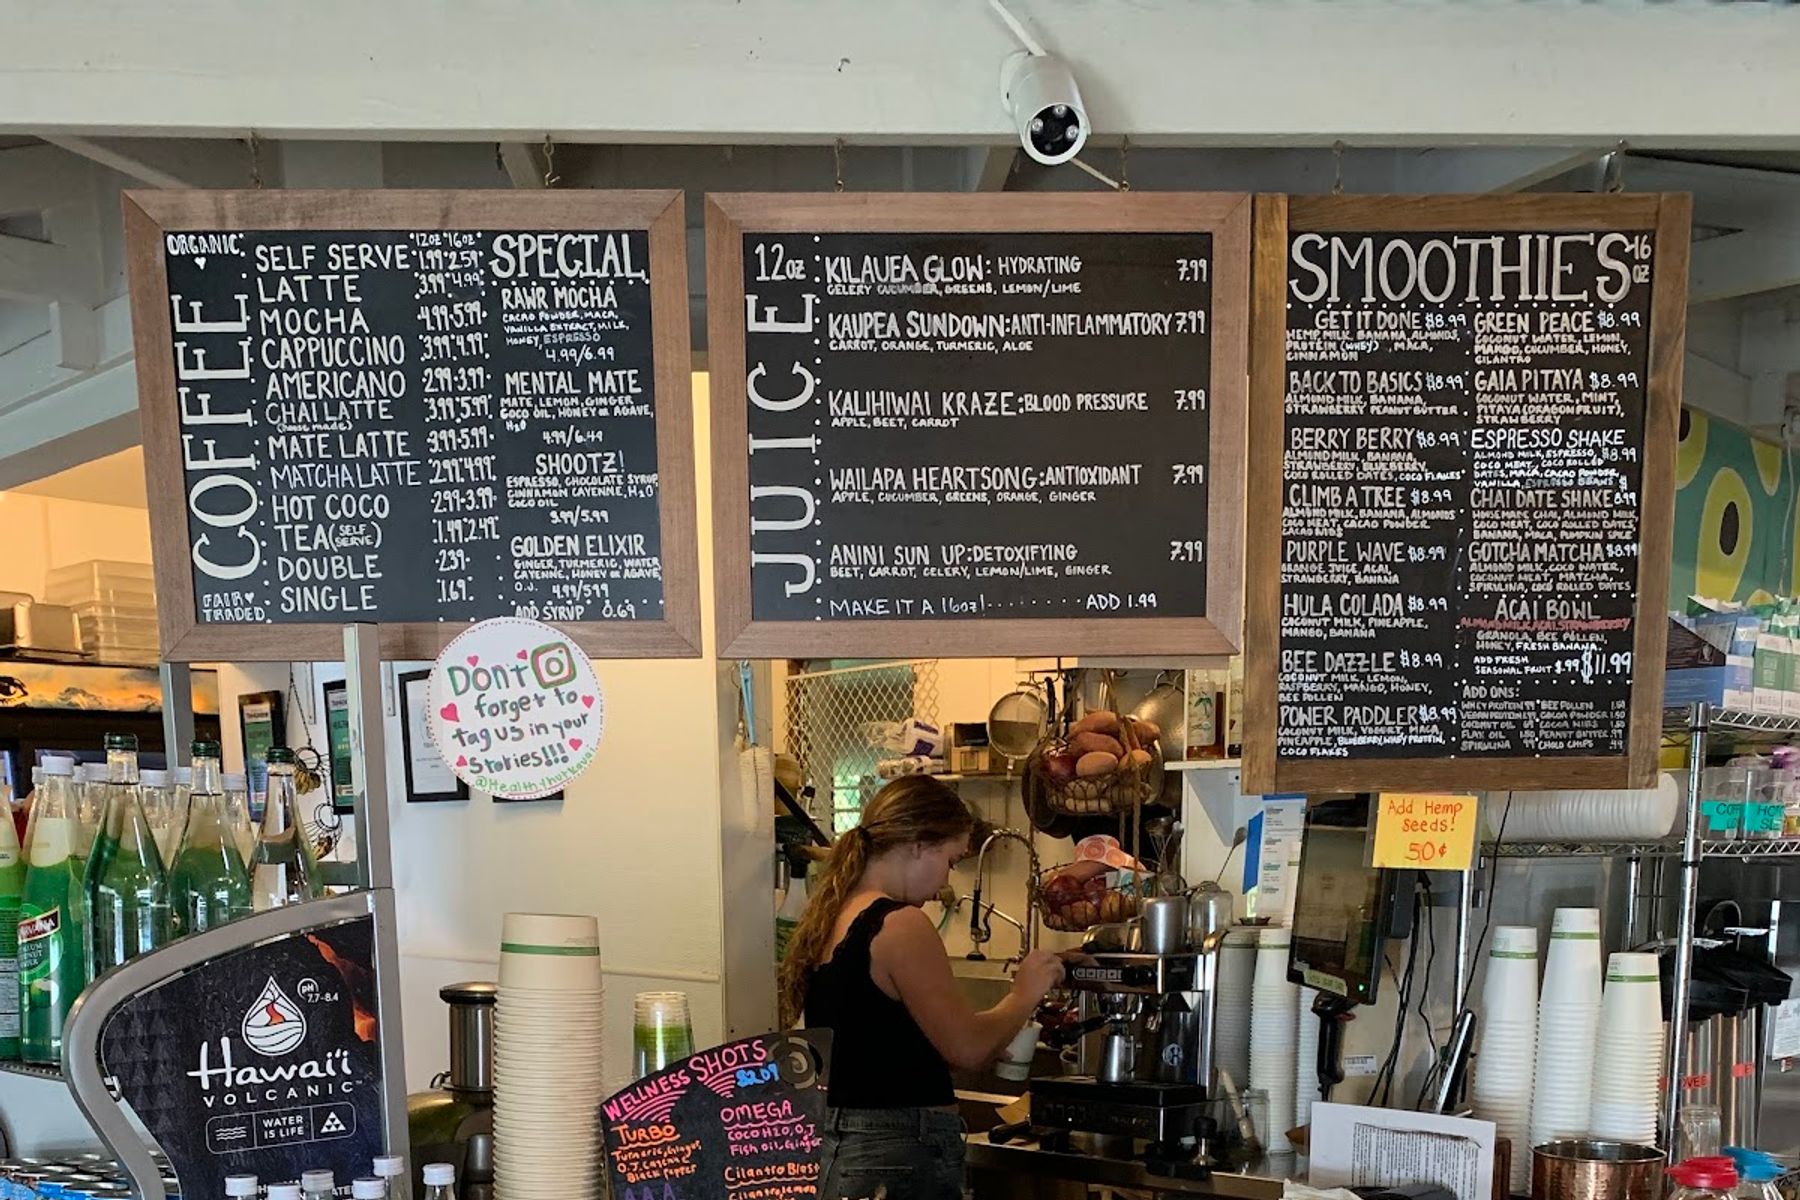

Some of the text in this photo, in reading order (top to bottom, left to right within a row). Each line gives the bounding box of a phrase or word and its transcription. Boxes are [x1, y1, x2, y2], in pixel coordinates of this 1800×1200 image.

[166, 233, 241, 255] ORGANIC
[489, 233, 647, 280] SPECIAL
[1633, 234, 1651, 261] 16
[255, 244, 411, 272] SELF SERVE
[825, 253, 919, 284] KILAUEA
[998, 255, 1083, 276] HYDRATING
[1175, 258, 1208, 283] 7.99
[1288, 232, 1632, 304] SMOOTHIES
[257, 274, 363, 303] LATTE
[501, 285, 618, 310] RAWR MOCHA
[827, 279, 1082, 298] CELERY LEMON/LIME
[259, 307, 370, 336] MOCHA
[453, 301, 482, 328] 5.99
[828, 311, 901, 340] KAUPEA
[1174, 309, 1206, 335] 7.99
[1315, 309, 1467, 331] GET IT DONE $8.99
[1474, 309, 1641, 334] GREEN PEACE $8.99
[260, 335, 405, 369] CAPPUCCINO
[545, 344, 615, 367] 4.99/6.99
[1002, 340, 1034, 352] ALOE
[265, 370, 407, 400] AMERICANO
[505, 369, 642, 396] MENTAL MATE
[1289, 370, 1423, 394] BACK TO BASICS
[1474, 367, 1584, 393] GAIA PITAYA
[265, 400, 394, 425] CHAI LATTE
[828, 388, 931, 418] KALIHIWAI
[1076, 392, 1150, 412] PRESSURE
[1173, 389, 1206, 411] 7.99
[911, 417, 960, 429] CARROT
[170, 294, 261, 580] COFFEE
[268, 430, 412, 460] MATE LATTE
[745, 294, 817, 598] JUICE
[1291, 426, 1416, 451] BERRY BERRY
[1470, 427, 1626, 450] ESPRESSO SHAKE
[270, 461, 422, 489] MATCHA LATTE
[535, 450, 625, 476] SHOOTZ!
[564, 474, 624, 486] CHOCOLATE
[829, 467, 907, 492] WAILAPA
[271, 493, 391, 522] HOT COCO
[1048, 490, 1097, 503] GINGER
[1288, 483, 1407, 508] CLIMB A TREE
[1470, 488, 1614, 509] CHAI DATE SHAKE
[510, 532, 646, 557] GOLDEN ELIXIR
[829, 544, 884, 566] ANINI
[894, 545, 930, 566] SUN
[1286, 540, 1406, 564] PURPLE WAVE
[1468, 541, 1606, 562] GOTCHA MATCHA
[277, 554, 382, 582] DOUBLE
[202, 591, 265, 623] FAIR TRADED
[280, 585, 378, 613] SINGLE
[514, 603, 585, 620] ADD SYRUP
[829, 598, 890, 617] MAKE
[895, 598, 914, 615] IT
[921, 598, 935, 616] A
[1086, 594, 1121, 611] ADD
[1127, 593, 1158, 609] 1.99
[1283, 592, 1404, 617] HULA COLADA
[1495, 598, 1602, 621] ACAI BOWL
[1282, 650, 1397, 674] BEE DAZZLE
[1581, 651, 1632, 684] $11.99
[474, 687, 578, 723] forget to
[1279, 705, 1419, 727] POWER PADDLER
[451, 711, 589, 753] tag us in your
[1387, 798, 1464, 818] Add Hemp
[301, 984, 315, 994] pH
[602, 1039, 769, 1122] WELLNESS SHOTS
[202, 1080, 355, 1109] VOLCANIC
[262, 1115, 304, 1129] WATER
[720, 1100, 793, 1123] OMEGA
[264, 1126, 305, 1140] IS LIFE
[610, 1123, 676, 1144] TURBO
[724, 1165, 786, 1182] Cilantro
